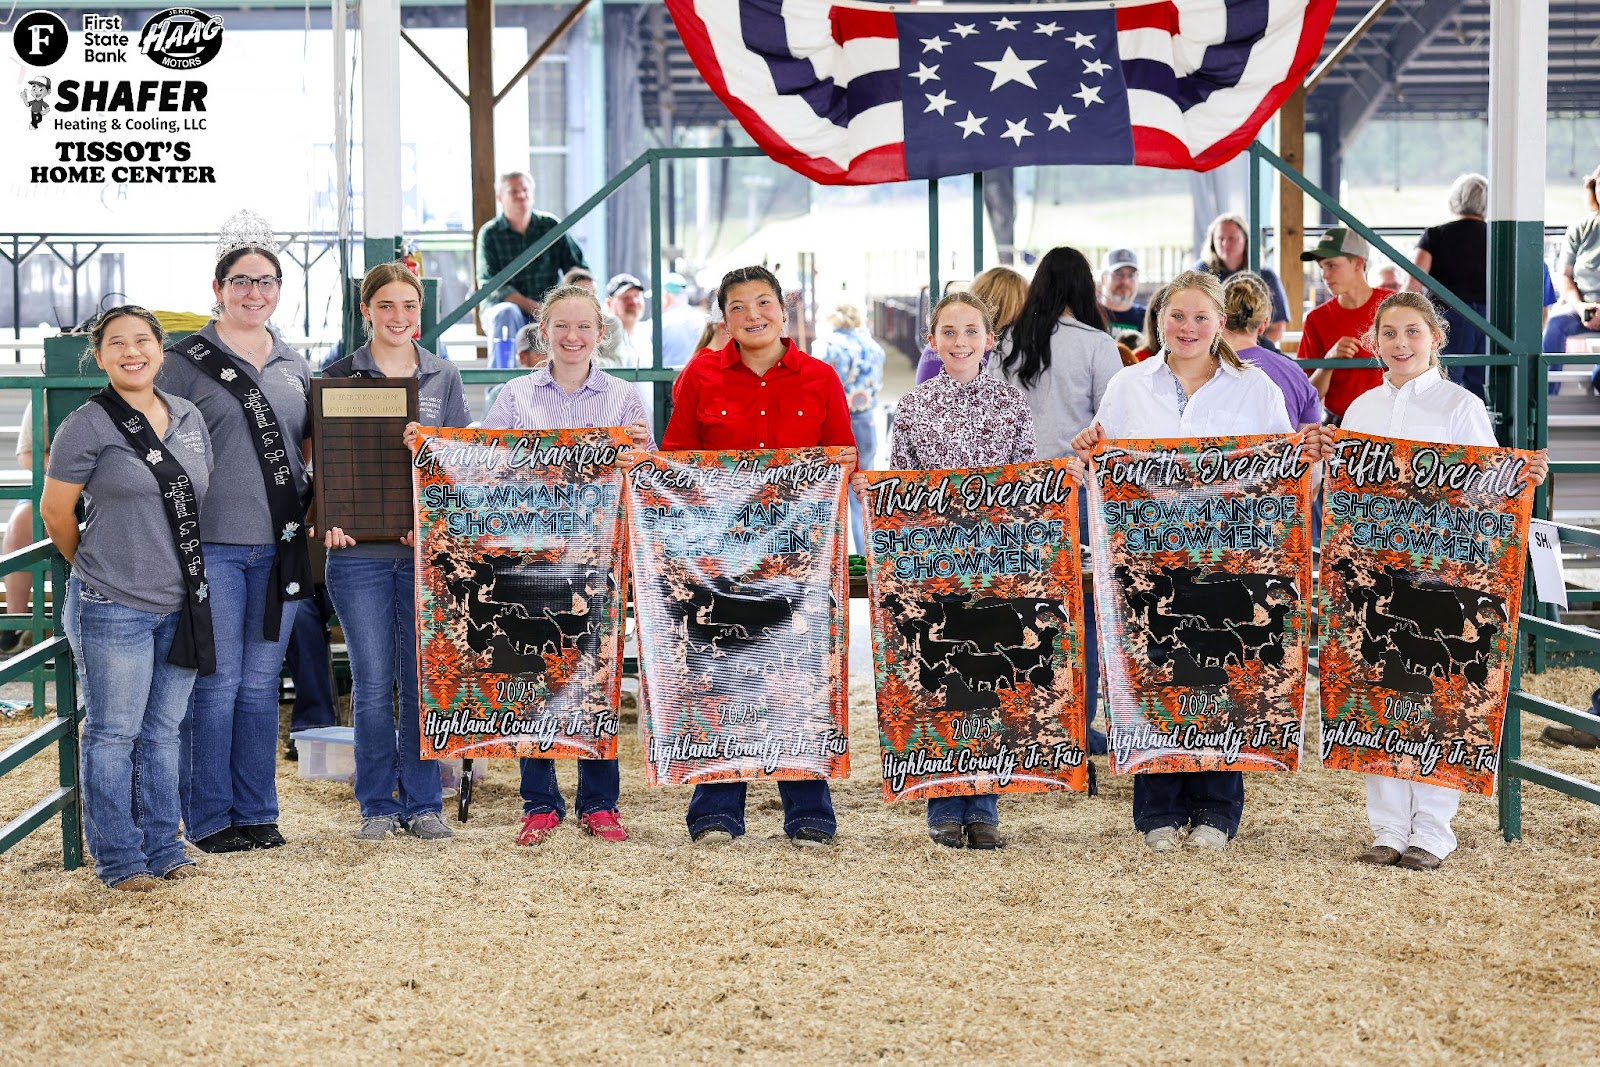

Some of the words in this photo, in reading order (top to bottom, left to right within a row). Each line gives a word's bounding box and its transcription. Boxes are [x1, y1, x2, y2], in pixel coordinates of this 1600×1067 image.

[244, 388, 275, 429] Highland
[274, 465, 291, 486] Fair
[414, 437, 500, 474] Grand
[1093, 449, 1186, 488] Fourth
[1197, 444, 1310, 483] Overall
[1329, 439, 1398, 487] Fifth
[1411, 448, 1528, 497] Overall
[629, 460, 720, 492] Reserve
[730, 460, 844, 491] Champion
[867, 477, 951, 516] Third
[959, 469, 1071, 512] Overall
[425, 484, 574, 511] SHOWMAN
[1104, 497, 1252, 526] SHOWMAN
[1255, 496, 1296, 521] OF
[1331, 491, 1475, 533] SHOWMAN
[1479, 512, 1515, 538] OF
[164, 475, 193, 518] Highland
[188, 555, 202, 576] Fair
[448, 511, 594, 536] SHOWMEN
[640, 502, 789, 531] SHOWMAN
[795, 501, 832, 526] OF
[664, 529, 811, 558] SHOWMEN
[872, 524, 1024, 554] SHOWMAN
[1026, 520, 1063, 546] OF
[1126, 525, 1273, 553] SHOWMEN
[1353, 522, 1489, 564] SHOWMEN
[895, 549, 1041, 579] SHOWMEN
[496, 681, 536, 704] 2025
[1177, 693, 1218, 716] 2025
[717, 702, 758, 726] 2025
[1384, 696, 1422, 725] 2025
[424, 711, 497, 750] Highland
[501, 712, 560, 751] County
[566, 712, 588, 737] Jr.
[950, 717, 991, 741] 2025
[1183, 724, 1245, 764] County
[1250, 723, 1277, 749] Jr.
[1281, 722, 1301, 748] Fa
[649, 733, 721, 774] Highland
[723, 735, 784, 773] County
[791, 732, 814, 755] Jr.
[1322, 720, 1383, 760] ighland
[1385, 726, 1442, 776] County
[1447, 740, 1472, 765] Jr.
[1476, 745, 1498, 773] Fai
[883, 750, 955, 792] Highland
[957, 748, 1018, 787] County
[1023, 744, 1049, 769] Jr.
[1053, 741, 1085, 768] Fair
